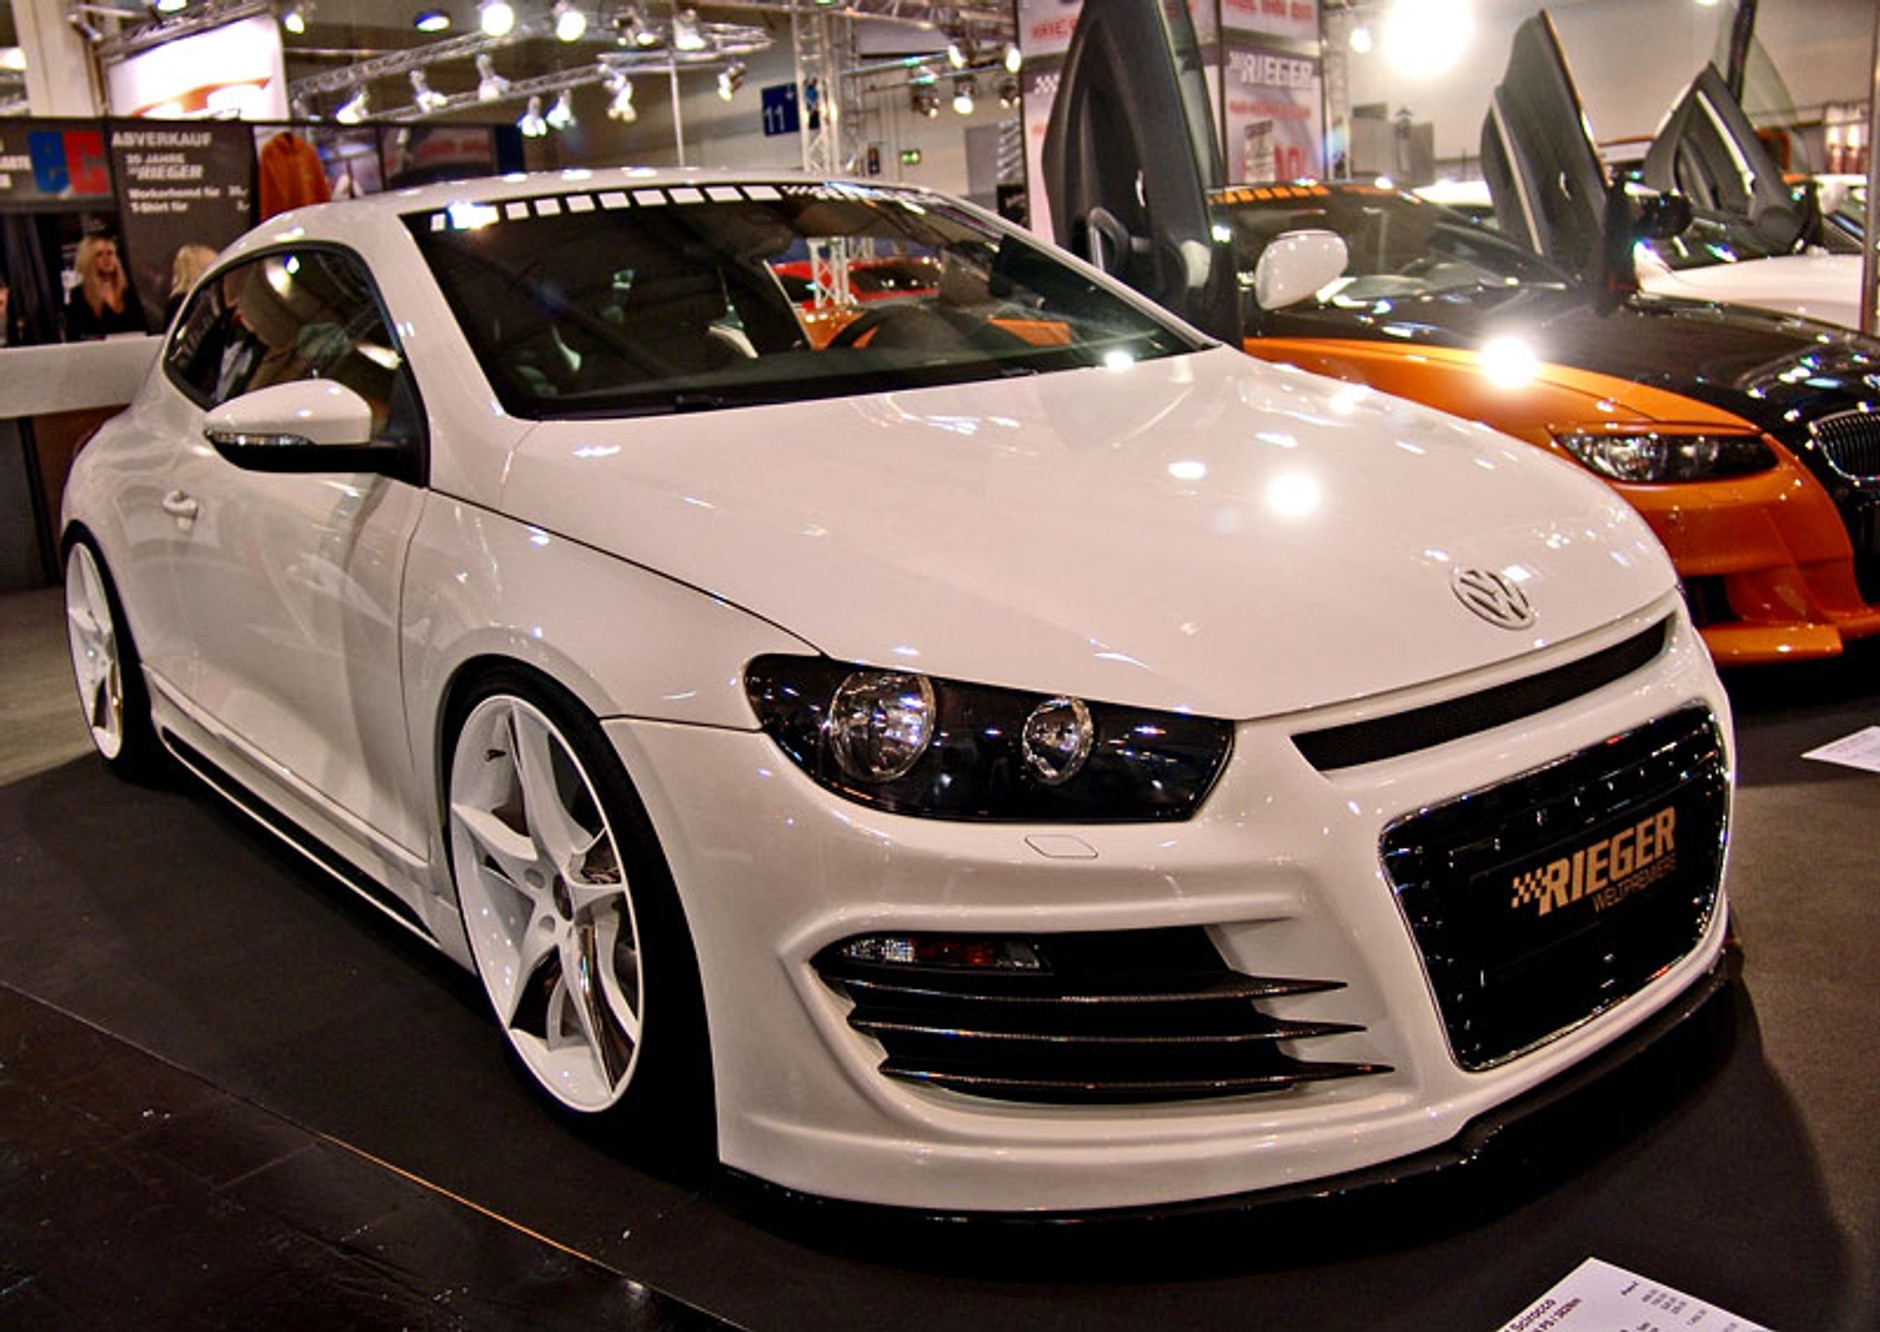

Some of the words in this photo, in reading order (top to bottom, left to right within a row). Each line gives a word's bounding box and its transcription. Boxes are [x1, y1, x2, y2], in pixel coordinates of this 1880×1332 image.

[1241, 53, 1313, 88] RIEGER
[764, 104, 785, 134] 11
[112, 131, 212, 147] ABVERKAUF
[138, 165, 203, 180] RIEGER
[1539, 805, 1676, 917] RIEGER
